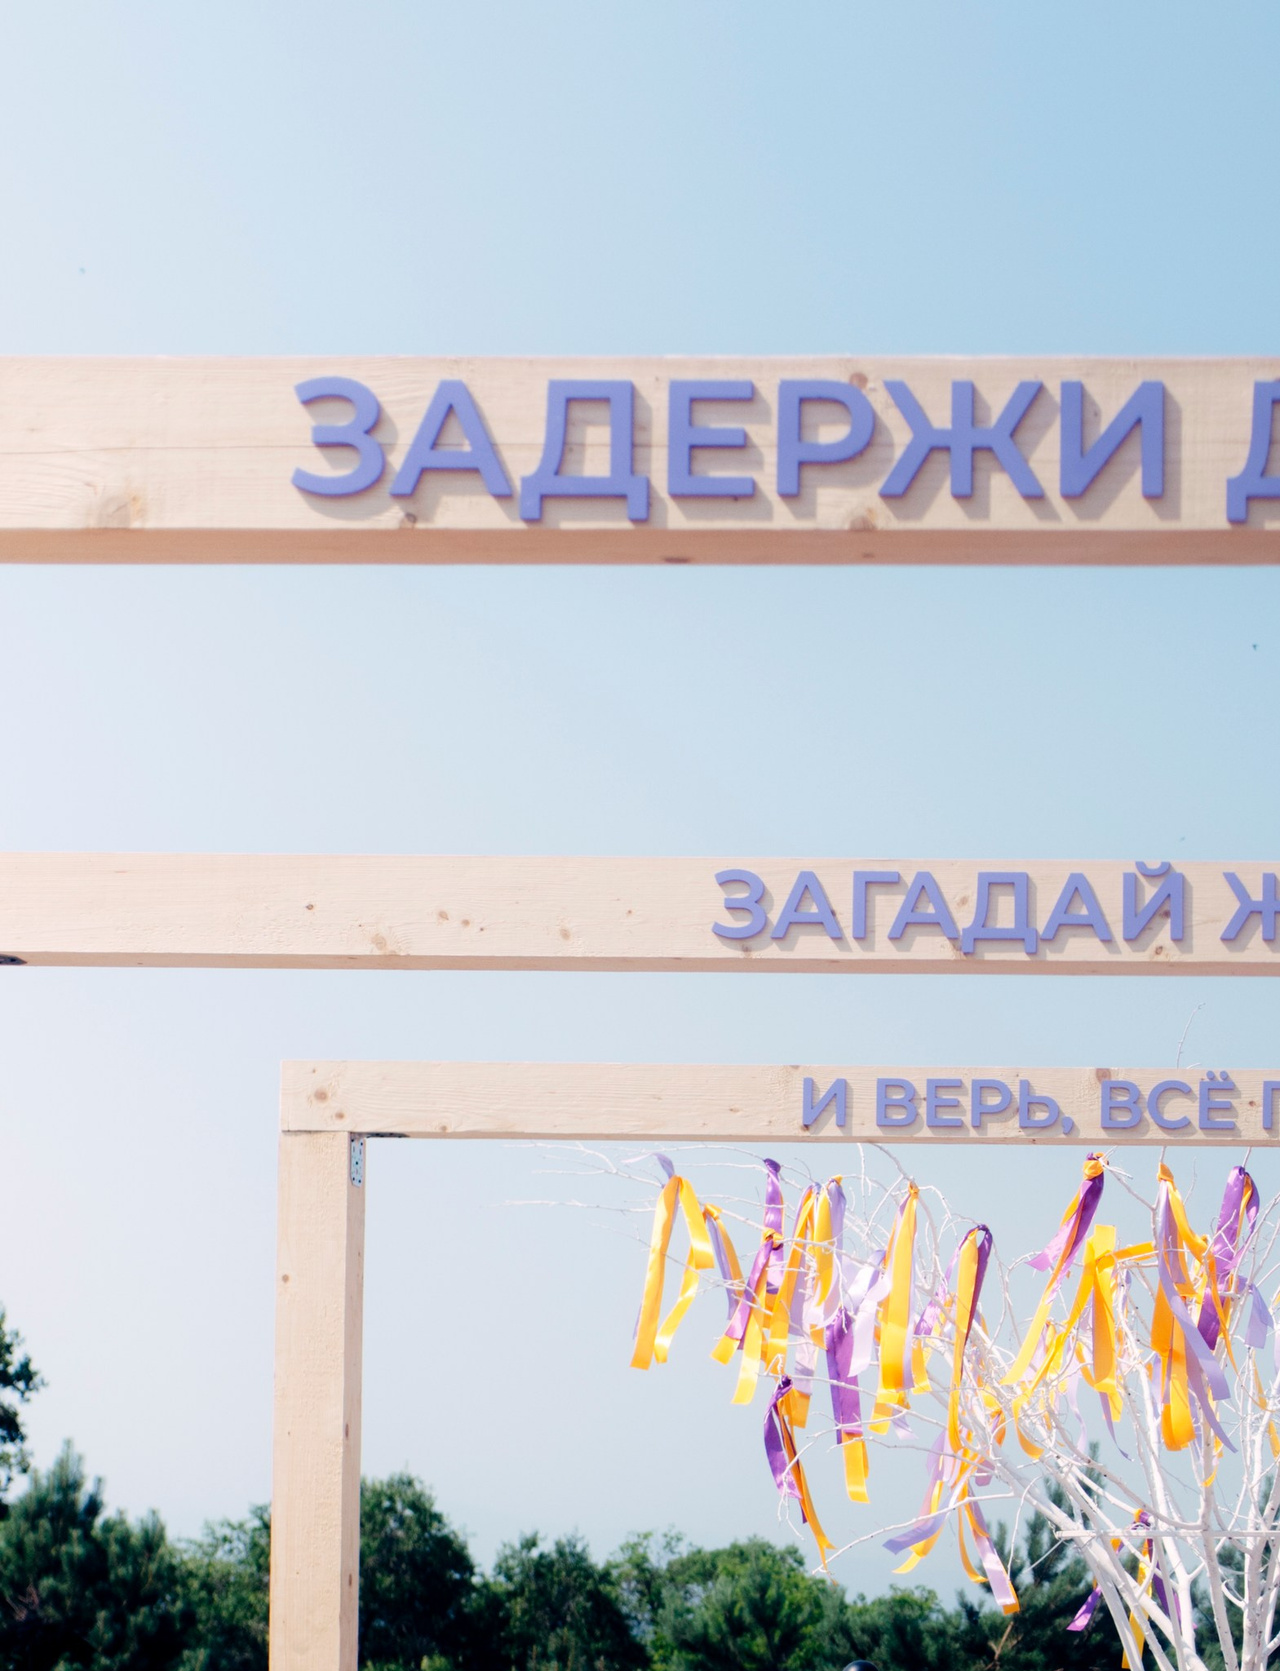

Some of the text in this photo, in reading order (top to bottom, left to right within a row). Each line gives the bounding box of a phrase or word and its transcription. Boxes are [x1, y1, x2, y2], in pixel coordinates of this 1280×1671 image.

[291, 376, 1164, 523] ЗАДЕРЖИ
[712, 861, 1184, 955] ЗАГАДАЙ
[802, 1077, 847, 1127] И
[875, 1077, 1074, 1136] ВЕРЬ,
[1100, 1070, 1237, 1130] ВСЁ
